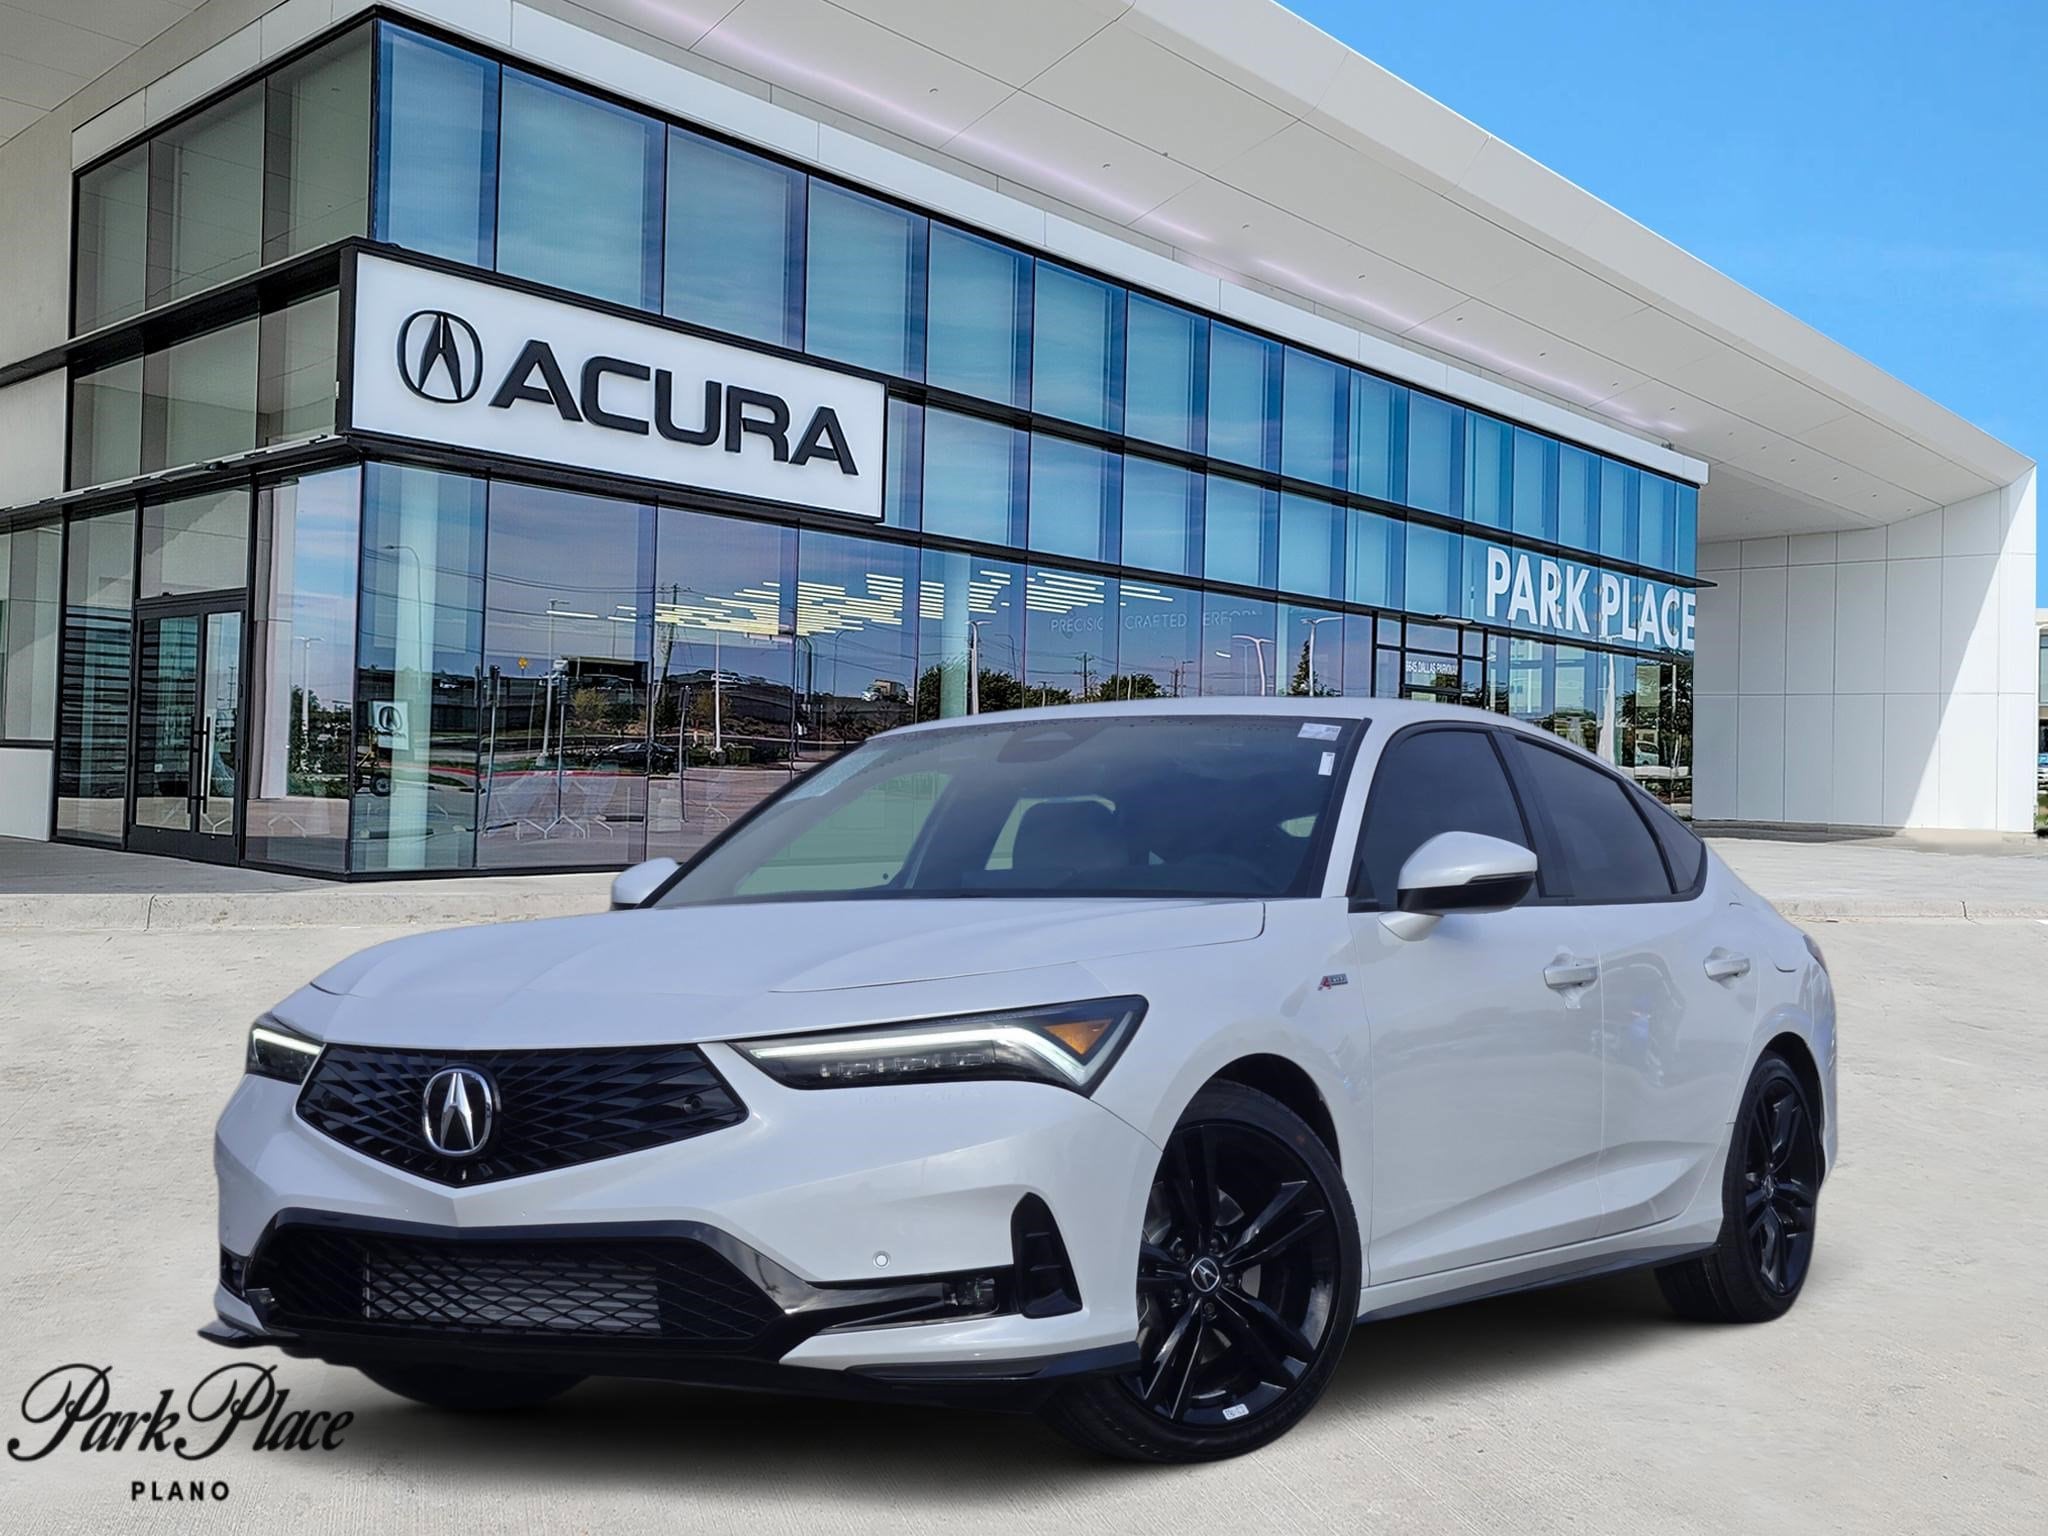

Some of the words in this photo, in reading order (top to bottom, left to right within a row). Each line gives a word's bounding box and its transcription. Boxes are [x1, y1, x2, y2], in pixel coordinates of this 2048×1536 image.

[488, 339, 859, 476] ACURA
[1486, 546, 1591, 634] PARK
[1601, 573, 1695, 651] PLACE
